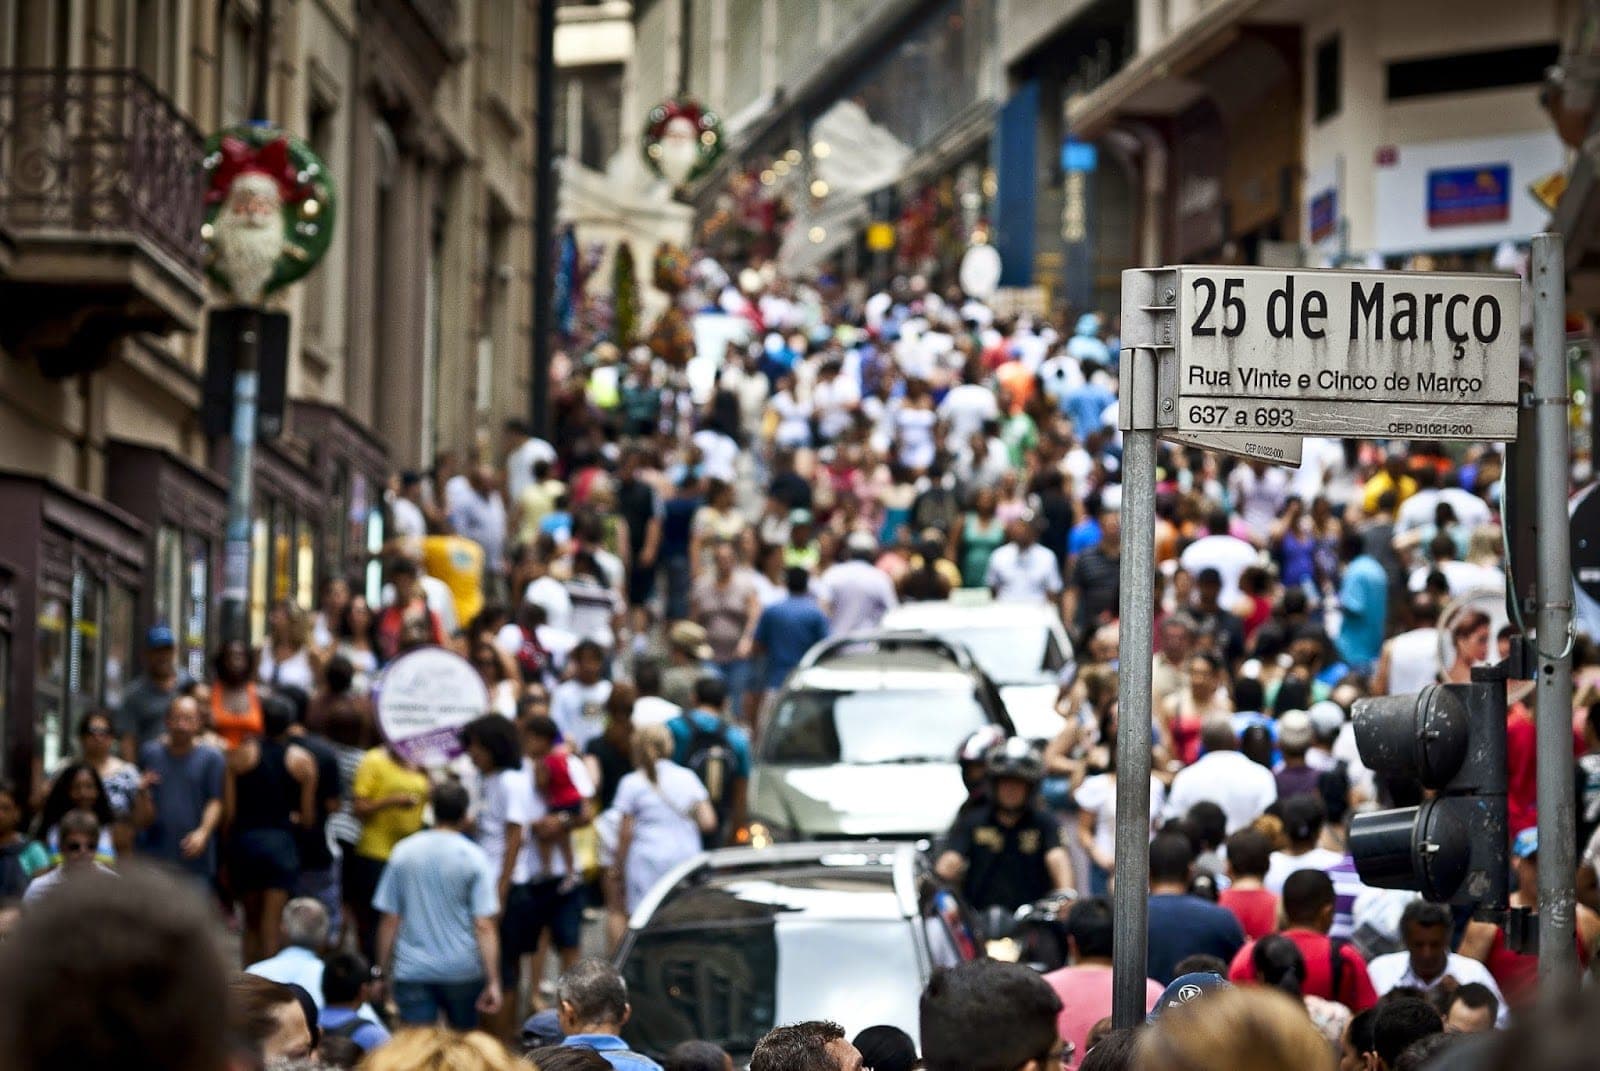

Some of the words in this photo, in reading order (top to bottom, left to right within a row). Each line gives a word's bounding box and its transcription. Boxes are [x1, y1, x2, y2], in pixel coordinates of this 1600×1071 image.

[1190, 276, 1247, 338] 25
[1266, 275, 1328, 339] de
[1350, 281, 1501, 360] Março
[1189, 366, 1231, 387] Rua
[1238, 367, 1292, 389] Vinte
[1297, 374, 1310, 389] e
[1317, 370, 1377, 391] Cinco
[1384, 374, 1410, 391] de
[1417, 371, 1482, 397] Março
[1189, 406, 1228, 425] 637
[1234, 411, 1248, 426] a
[1255, 408, 1293, 426] 693
[1388, 423, 1413, 433] CEP
[1415, 423, 1473, 434] 01021-200
[1244, 442, 1257, 453] CEP
